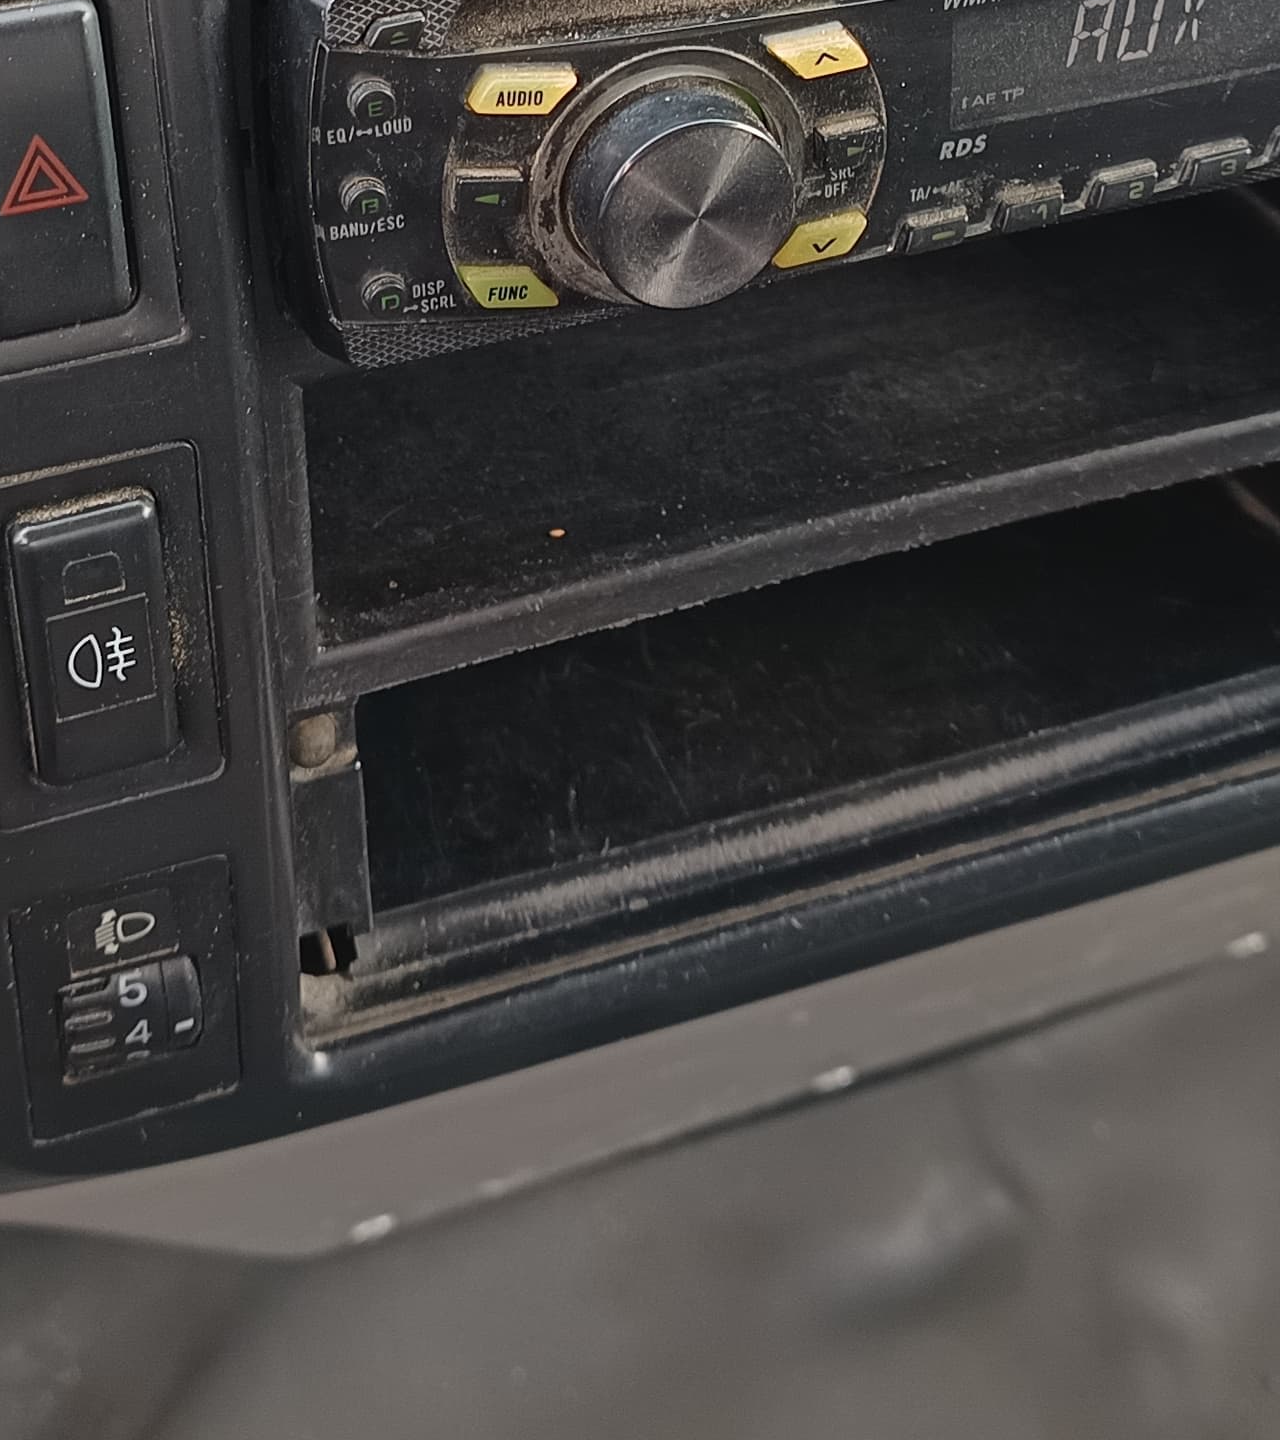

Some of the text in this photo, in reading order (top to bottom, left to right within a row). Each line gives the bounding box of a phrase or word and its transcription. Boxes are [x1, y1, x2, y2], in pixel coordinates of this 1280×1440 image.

[495, 90, 544, 108] AUDIO
[374, 117, 413, 138] LOUD
[939, 133, 988, 160] RDS
[1221, 160, 1237, 176] 3
[824, 180, 849, 199] OFF
[1129, 181, 1144, 199] 2
[329, 214, 405, 241] BAND/ESC
[412, 279, 446, 299] DISP
[488, 285, 528, 302] FUNC
[420, 294, 457, 313] SCRL
[118, 968, 148, 1008] 5
[125, 1019, 152, 1045] 4
